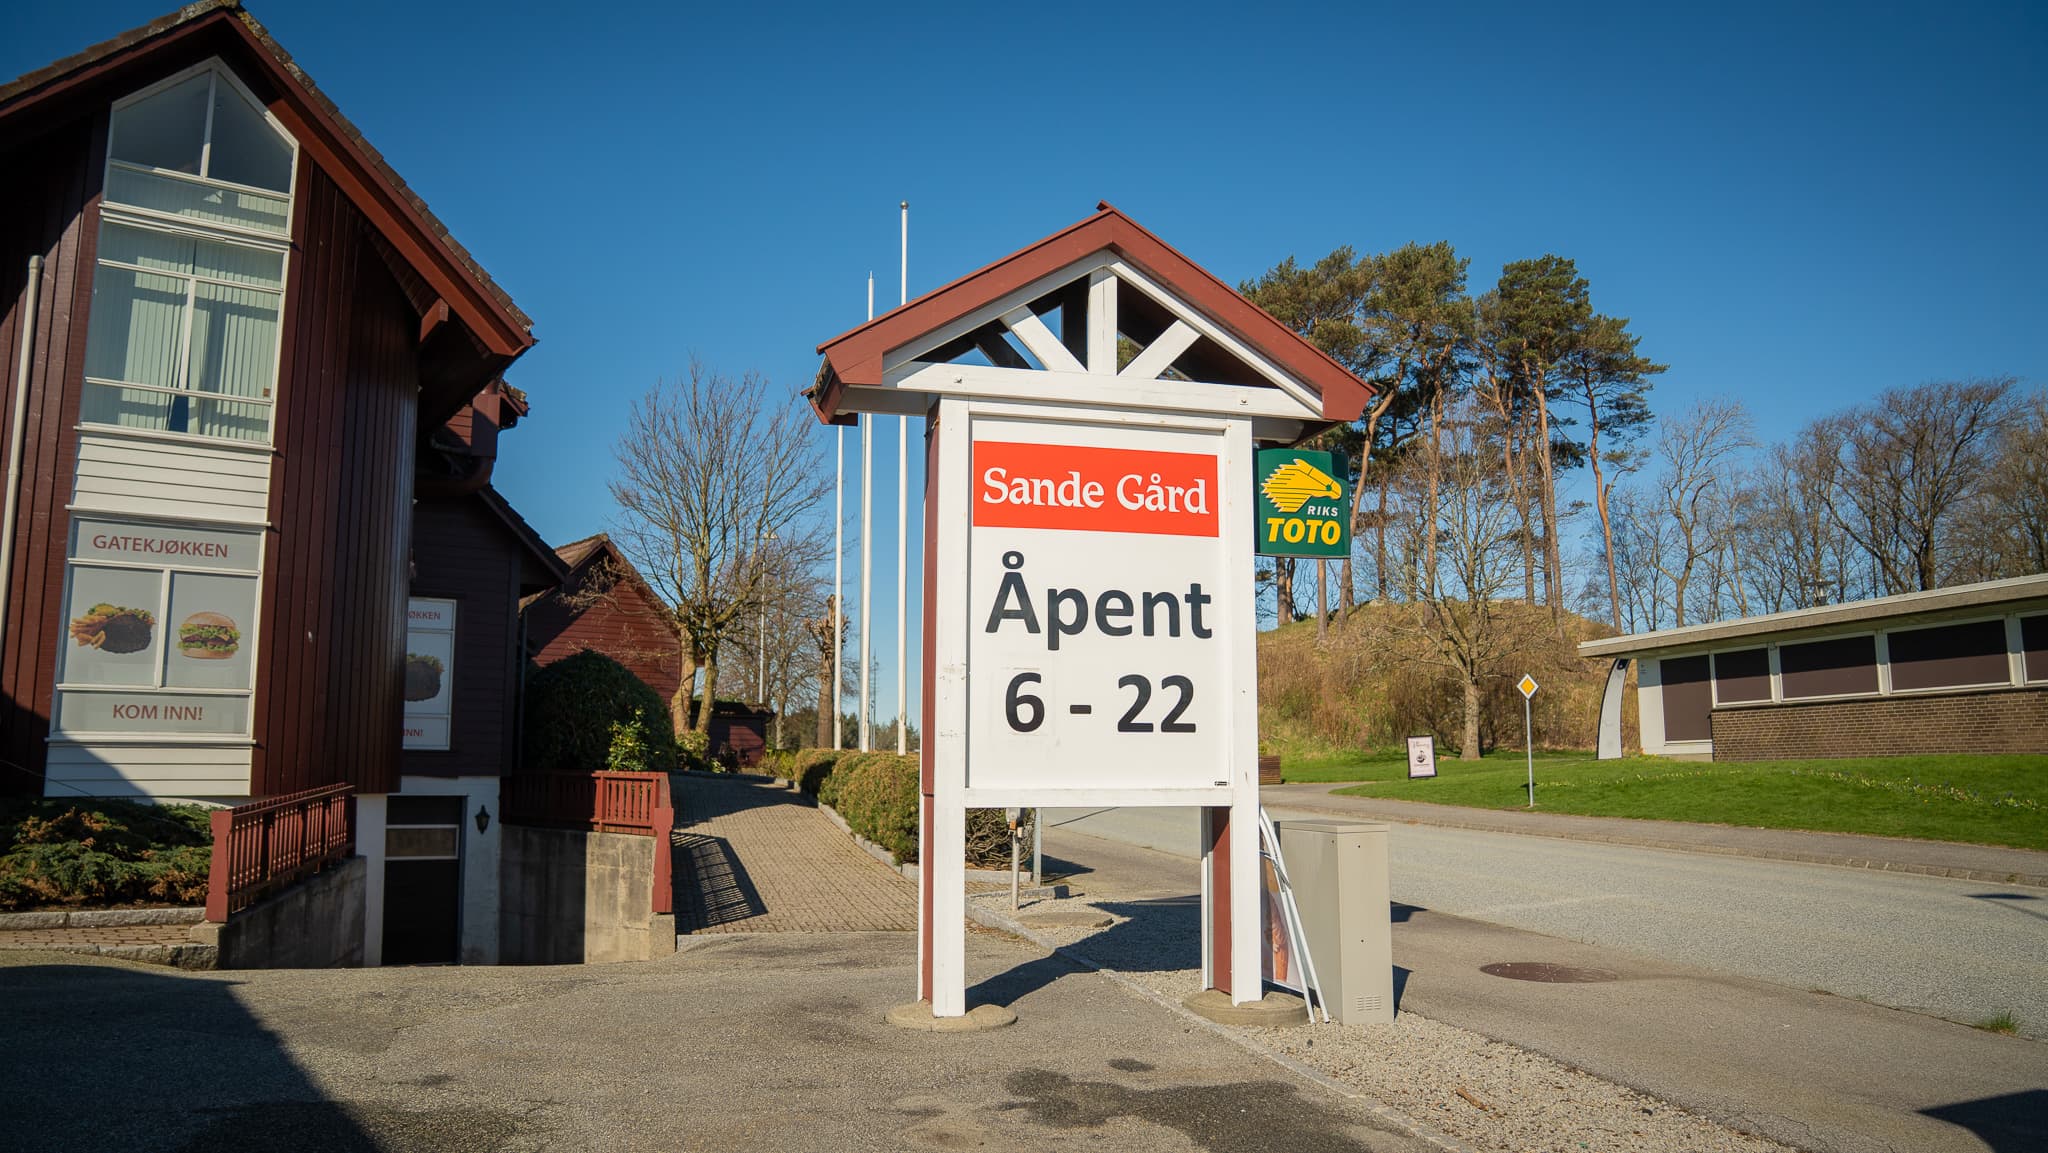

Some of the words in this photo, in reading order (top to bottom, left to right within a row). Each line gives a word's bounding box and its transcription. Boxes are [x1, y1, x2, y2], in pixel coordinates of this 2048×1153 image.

[983, 467, 1104, 509] Sande
[1116, 473, 1210, 516] Gård
[1307, 505, 1339, 517] RIKS
[1267, 517, 1342, 546] TOTO
[92, 533, 229, 558] GATEKJØKKEN
[985, 550, 1213, 651] Åpent
[408, 610, 441, 621] ØKKEN
[112, 703, 158, 721] KOM
[163, 704, 204, 722] INN!
[1005, 672, 1045, 733] 6
[1117, 674, 1197, 733] 22
